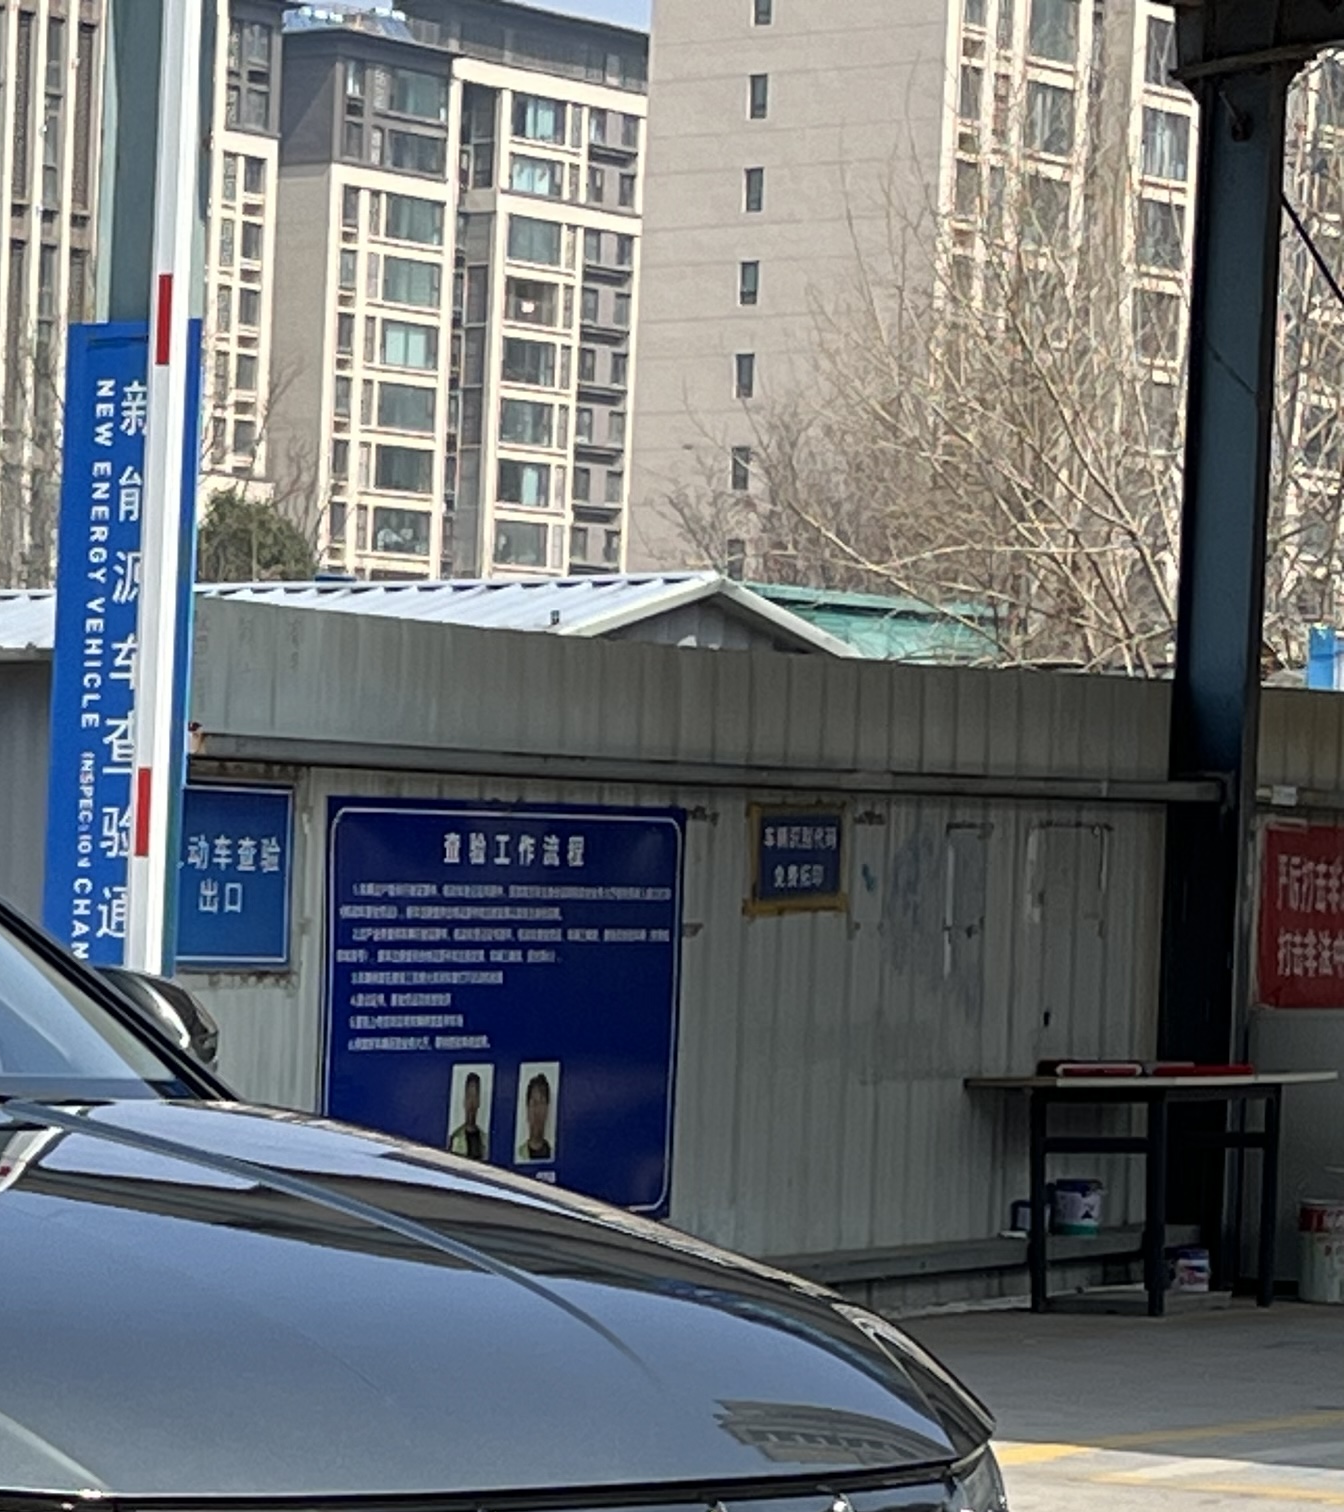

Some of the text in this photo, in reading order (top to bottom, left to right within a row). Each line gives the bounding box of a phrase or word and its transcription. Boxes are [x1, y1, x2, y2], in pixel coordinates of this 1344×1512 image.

[94, 379, 116, 446] NEW
[87, 461, 112, 584] ENERGY
[80, 597, 106, 729] VEHICLE
[176, 834, 281, 873] 动车查验
[443, 831, 584, 867] 查验工作流程
[198, 877, 243, 914] 出口
